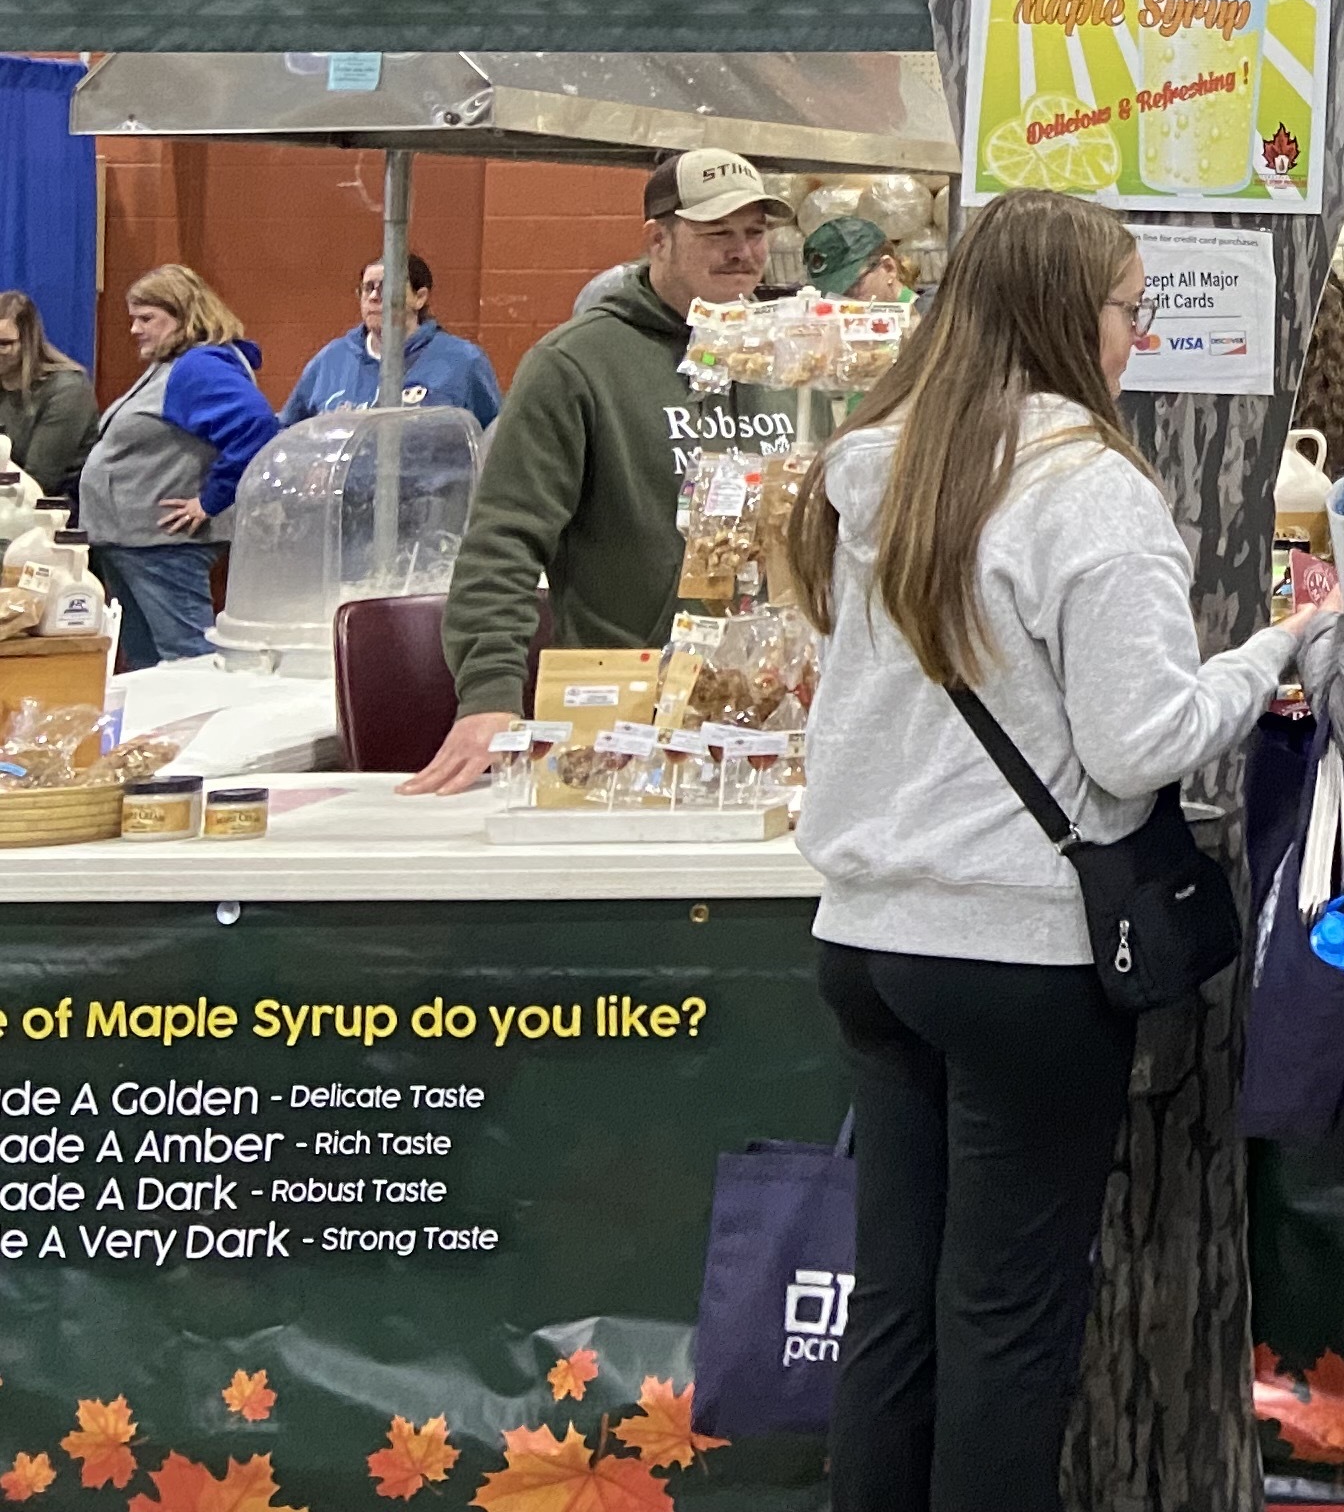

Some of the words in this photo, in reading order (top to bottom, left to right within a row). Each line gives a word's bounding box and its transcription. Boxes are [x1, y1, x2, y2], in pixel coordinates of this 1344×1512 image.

[1027, 107, 1111, 146] Delicious
[1136, 69, 1236, 114] Refreshing
[1145, 273, 1174, 291] cept
[1179, 271, 1196, 287] All
[1201, 271, 1239, 291] Major
[1174, 292, 1214, 308] Cards
[1170, 338, 1204, 350] VISA
[663, 406, 795, 440] Robson
[23, 997, 72, 1040] of
[86, 996, 238, 1046] Maple
[253, 998, 397, 1047] Syrup
[411, 996, 477, 1037] do
[489, 1004, 581, 1047] you
[597, 995, 707, 1037] like?
[70, 1083, 98, 1116] A
[112, 1079, 259, 1116] Golden
[290, 1083, 402, 1108] Delicate
[410, 1084, 485, 1108] Taste
[0, 1127, 84, 1163] ade
[96, 1130, 124, 1163] A
[135, 1127, 285, 1163] Amber
[314, 1130, 371, 1155] Rich
[377, 1132, 452, 1155] Taste
[0, 1174, 85, 1211] ade
[96, 1177, 125, 1211] A
[137, 1174, 238, 1211] Dark
[271, 1177, 366, 1203] Robust
[372, 1178, 448, 1203] Taste
[38, 1225, 66, 1259] A
[79, 1225, 177, 1266] Very
[186, 1220, 290, 1259] Dark
[321, 1226, 417, 1256] Strong
[423, 1225, 499, 1250] Taste
[782, 1336, 840, 1367] pcn
